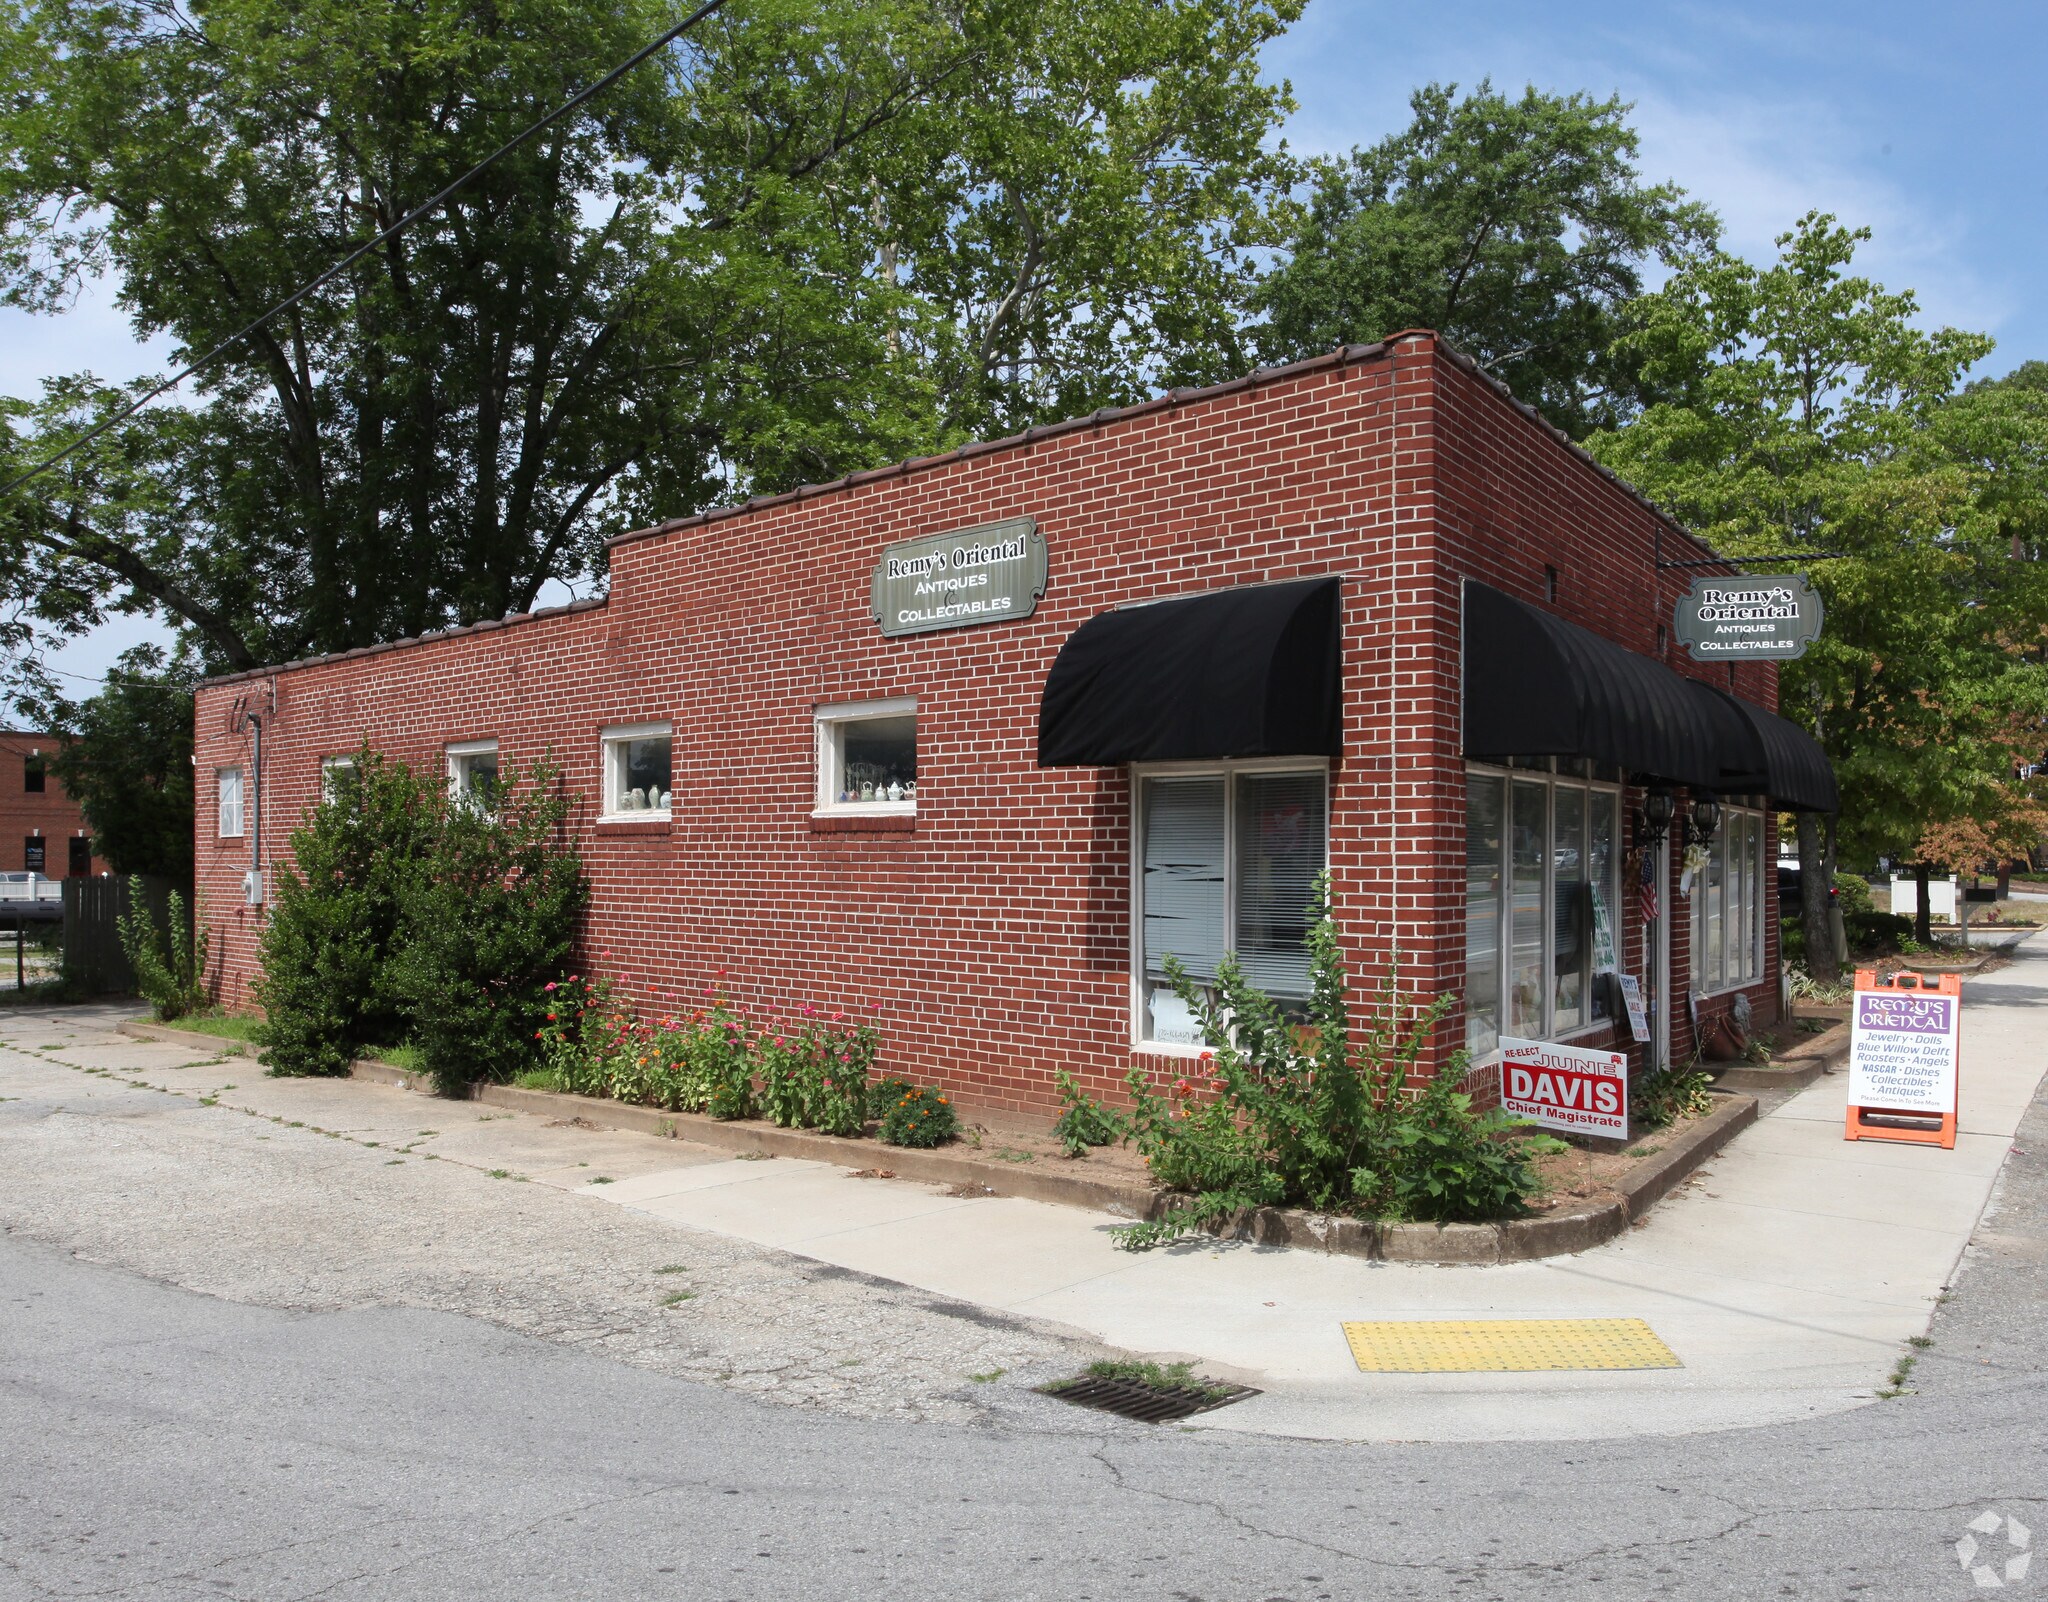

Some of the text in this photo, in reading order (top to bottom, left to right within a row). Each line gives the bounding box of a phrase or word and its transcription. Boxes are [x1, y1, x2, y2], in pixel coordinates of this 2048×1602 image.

[887, 534, 1026, 579] Remy's Oriental
[915, 574, 987, 595] ANTIQUES
[1703, 586, 1793, 606] Remy's
[898, 597, 1011, 623] COLLECTABLES
[1698, 602, 1799, 621] Oriental
[1715, 624, 1776, 634] ANTIQUES
[1700, 640, 1794, 650] COLLECTABLES
[1865, 1032, 1942, 1045] Jewelry Dolls
[1505, 1047, 1539, 1058] RE-ELECT
[1857, 1043, 1951, 1056] Blue Willow Delft
[1533, 1054, 1617, 1078] JUNE
[1857, 1053, 1949, 1067] Roosters Angels
[1862, 1064, 1940, 1077] NASCAR Dishes
[1871, 1075, 1933, 1087] Collectibles
[1510, 1068, 1618, 1113] DAVIS
[1877, 1085, 1926, 1097] Antiques
[1860, 1094, 1880, 1102] Please
[1506, 1101, 1622, 1128] Chief Magistrate
